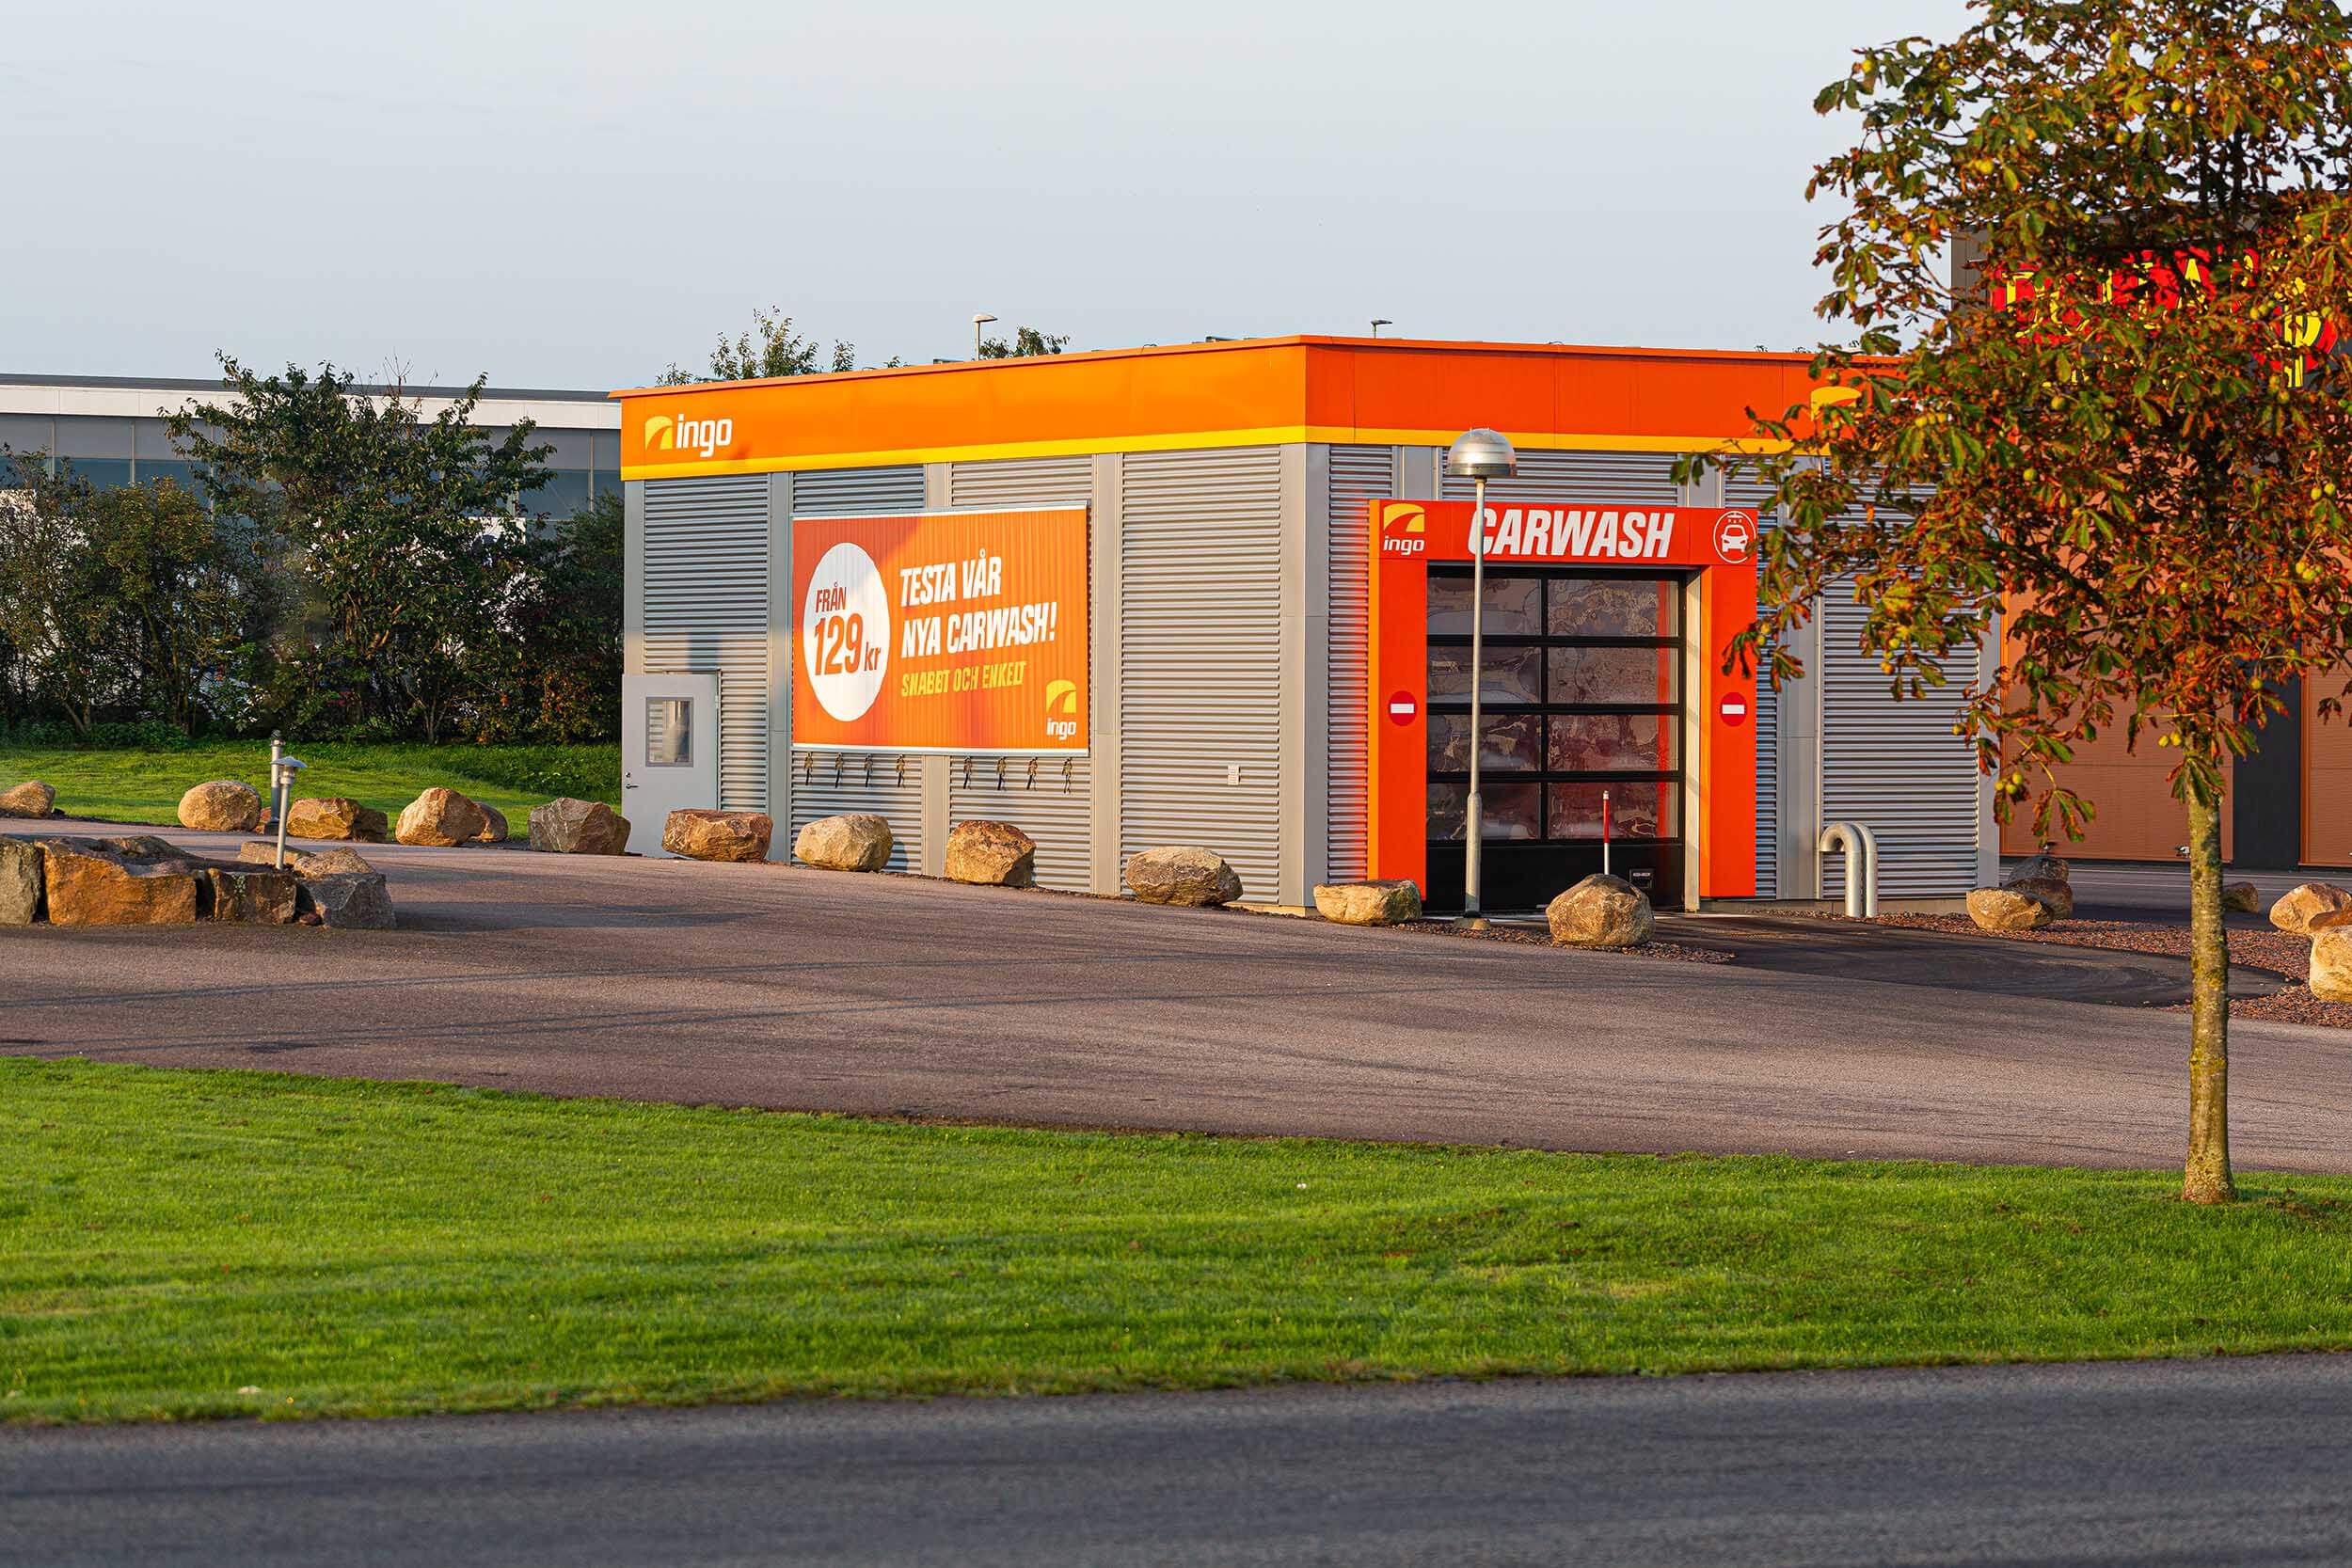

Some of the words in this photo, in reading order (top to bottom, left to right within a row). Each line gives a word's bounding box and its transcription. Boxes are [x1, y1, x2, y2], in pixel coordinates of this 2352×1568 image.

[675, 413, 732, 458] ingo
[1383, 535, 1425, 555] ingo
[1468, 508, 1675, 558] CARWASH
[815, 581, 847, 612] FRÅN
[900, 562, 956, 607] TESTA
[961, 548, 1002, 599] VÅR
[814, 612, 863, 676] 129
[864, 641, 882, 672] kr
[900, 616, 941, 658] NYA
[946, 601, 1057, 654] CARWASH!
[901, 669, 950, 697] SNABBT
[953, 666, 977, 692] OCH
[982, 661, 1026, 688] ENKELT
[1046, 718, 1076, 740] ingo
